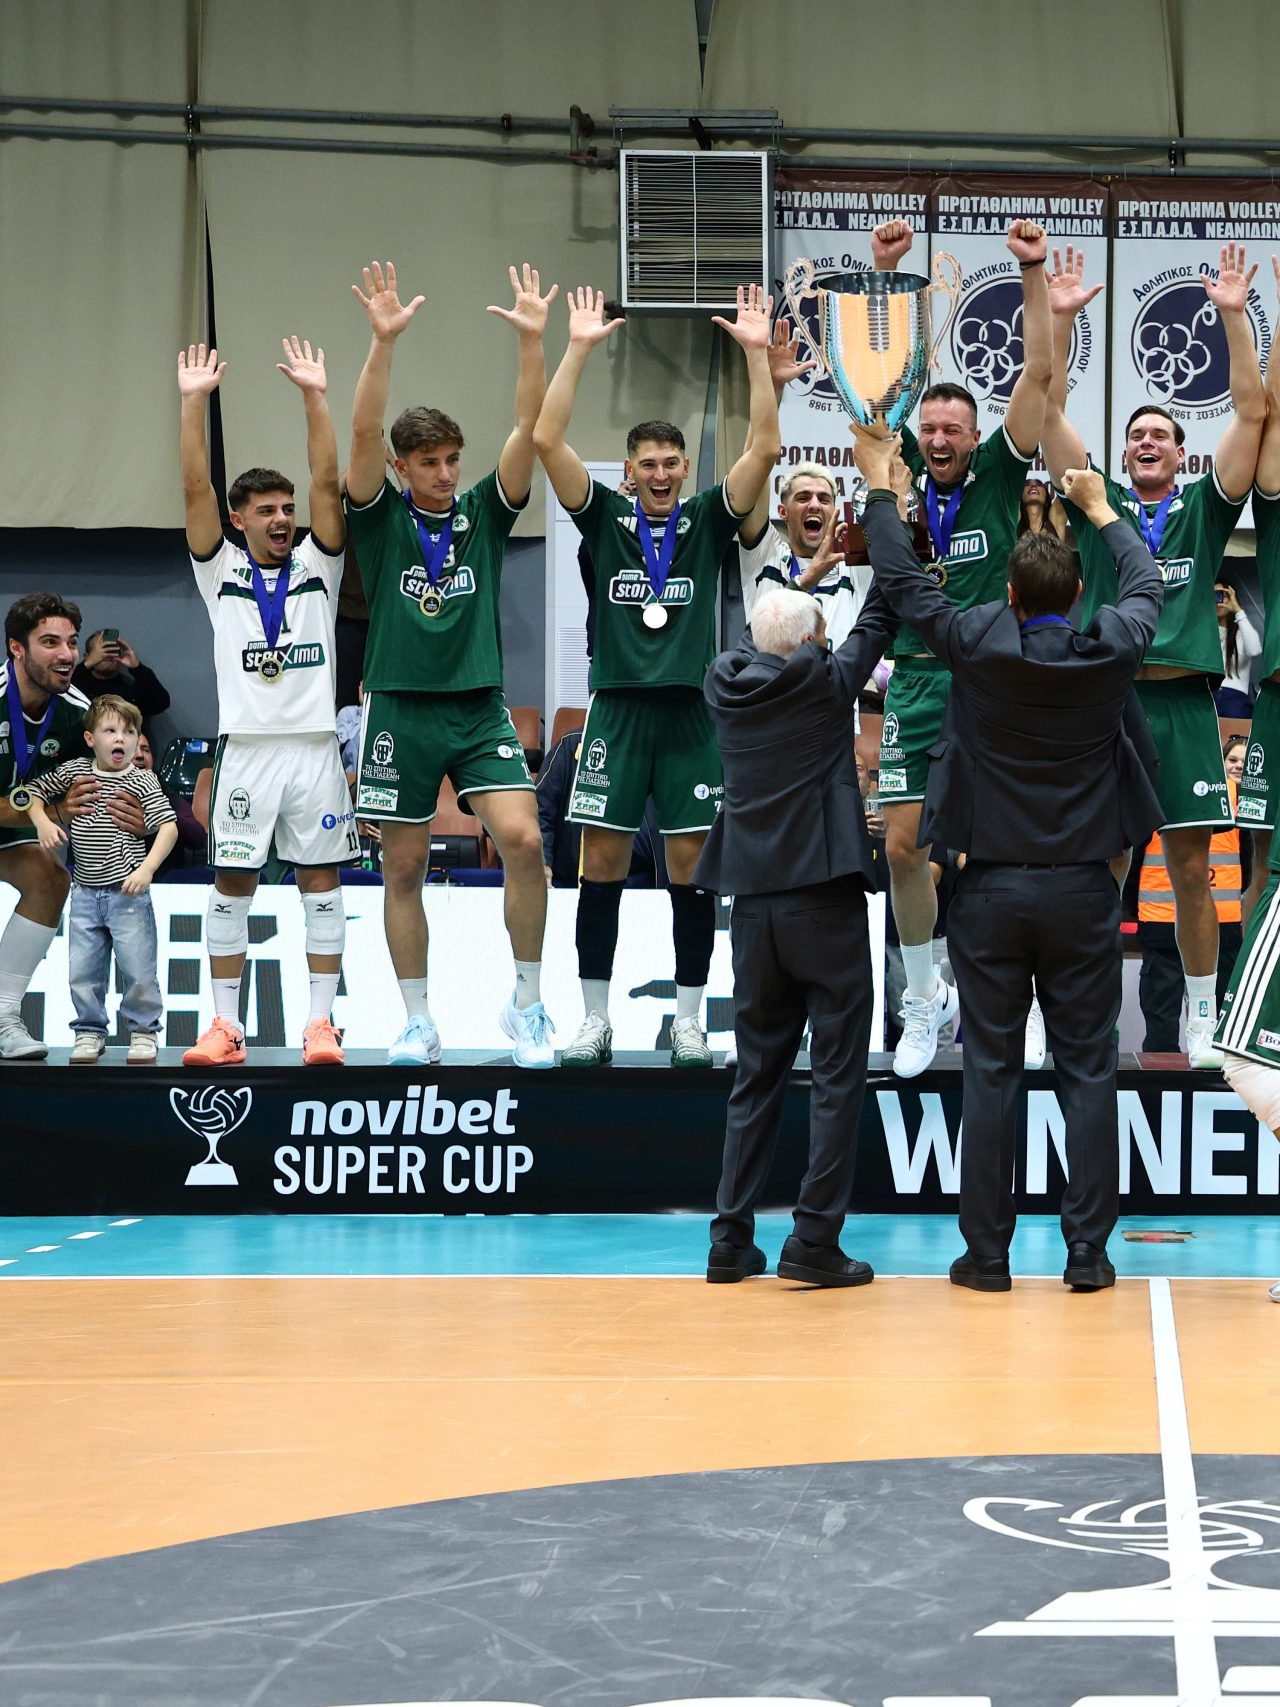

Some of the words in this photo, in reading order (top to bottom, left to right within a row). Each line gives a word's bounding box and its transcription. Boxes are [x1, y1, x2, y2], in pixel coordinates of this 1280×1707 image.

[774, 190, 869, 210] ΡΩΤΑΘΛΗΜΑ
[872, 193, 926, 211] VOLLEY
[938, 195, 1046, 214] ΠΡΩΤΑΘΛΗΜΑ
[1049, 198, 1103, 215] VOLLEY
[1118, 200, 1226, 219] ΠΡΩΤΑΘΛΗΜΑ
[1118, 221, 1197, 239] Ε.Σ.Π.Α.Α.Α.
[961, 261, 1014, 292] ΘΛΗΤΙΚΟΣ
[1132, 265, 1193, 302] ΑΘΛΗΤΙΚΟΣ
[1077, 307, 1092, 374] ΡΚΟΠΟΥΛΟΥ
[1220, 797, 1228, 816] 6
[346, 830, 359, 852] 11
[290, 1085, 518, 1135] novibet
[273, 1145, 426, 1195] SUPER
[443, 1145, 534, 1194] CUP
